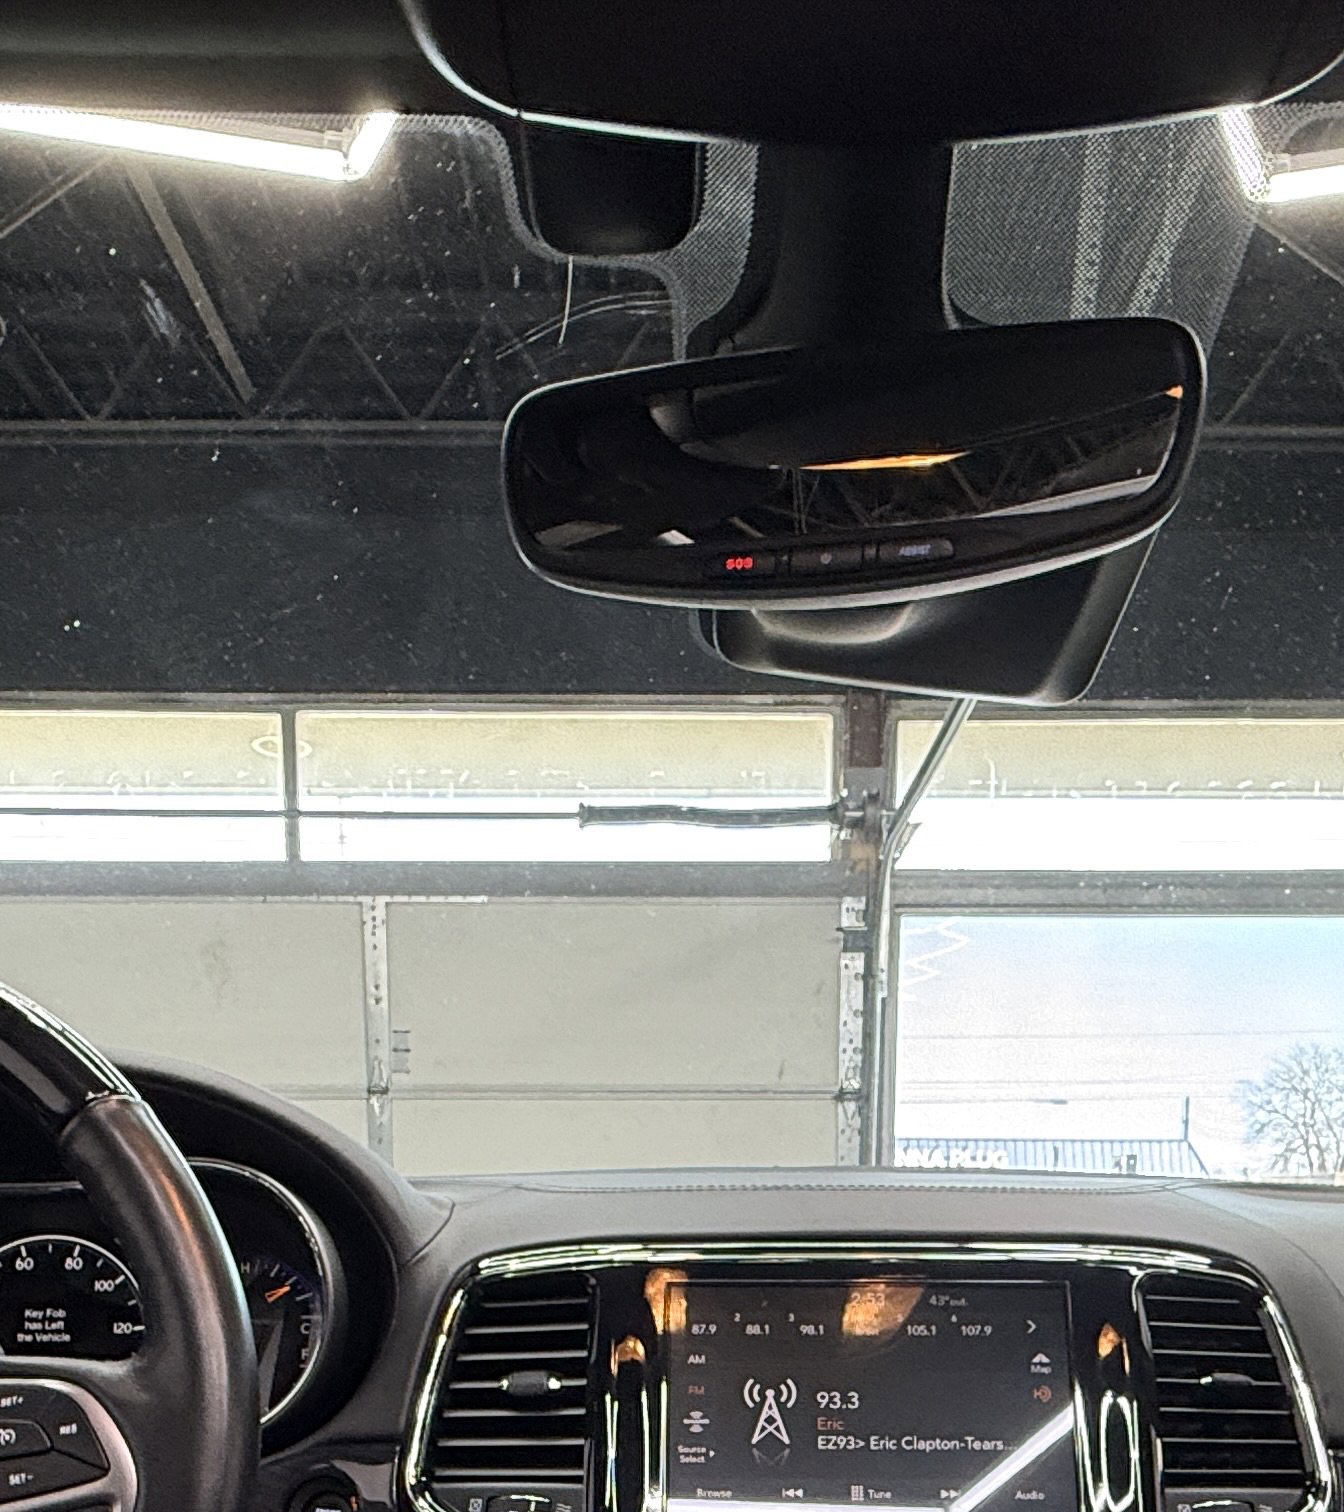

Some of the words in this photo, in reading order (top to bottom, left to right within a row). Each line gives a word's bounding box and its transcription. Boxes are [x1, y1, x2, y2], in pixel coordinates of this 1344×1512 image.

[726, 557, 753, 570] SOS
[15, 1257, 34, 1271] 60
[64, 1257, 83, 1271] 80
[240, 1262, 250, 1273] H
[94, 1279, 115, 1292] 100
[851, 1292, 885, 1307] 2:53
[24, 1308, 44, 1320] Key
[46, 1308, 66, 1318] Fob
[734, 1313, 741, 1322] 2
[24, 1321, 42, 1331] has
[45, 1321, 64, 1331] Left
[113, 1322, 133, 1335] 120
[300, 1323, 310, 1334] C
[691, 1324, 717, 1335] 87.9
[745, 1324, 770, 1335] 88.1
[799, 1324, 824, 1335] 98.1
[906, 1325, 937, 1336] 105.1
[960, 1325, 992, 1336] 107.9
[17, 1333, 34, 1342] the
[35, 1332, 71, 1342] Vehicle
[687, 1354, 706, 1365] AM
[1030, 1365, 1052, 1374] Map
[688, 1385, 705, 1395] FM
[816, 1391, 860, 1409] 93.3
[817, 1416, 844, 1431] Eric
[817, 1435, 865, 1450] EZ93>
[870, 1435, 898, 1450] Eric
[677, 1445, 706, 1454] Source
[679, 1455, 705, 1464] Select
[696, 1488, 732, 1498] Browse
[868, 1489, 892, 1499] Tune
[1014, 1490, 1045, 1500] Audio
